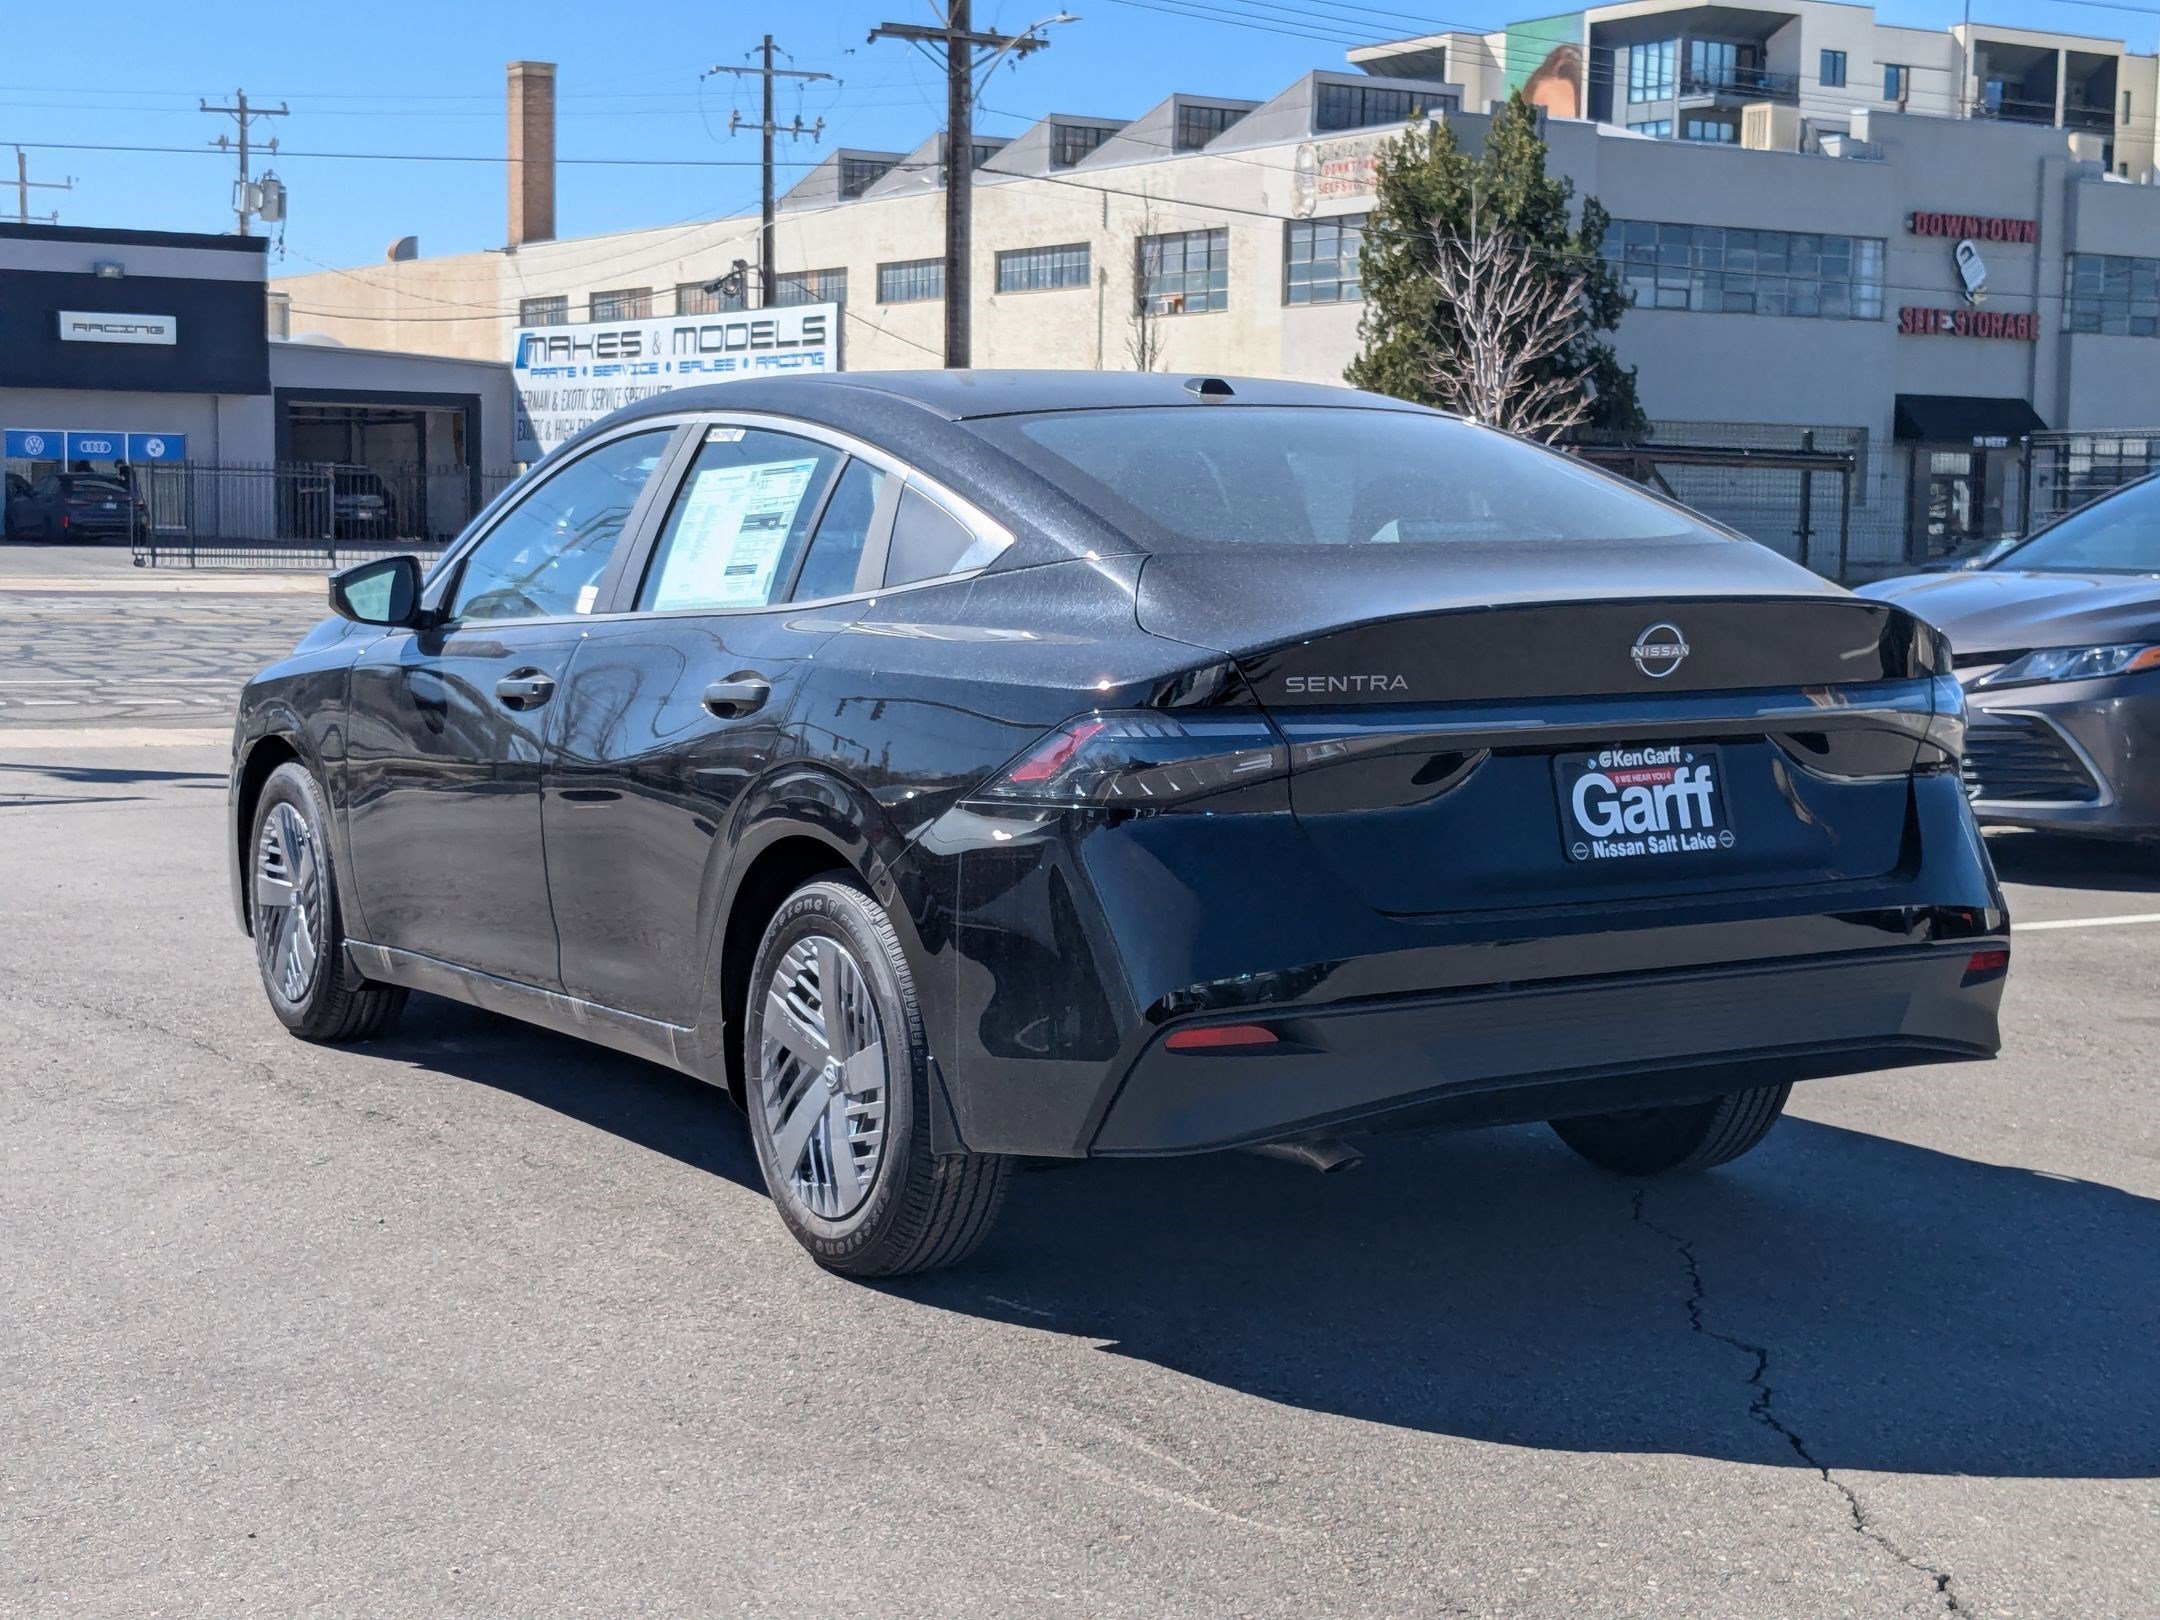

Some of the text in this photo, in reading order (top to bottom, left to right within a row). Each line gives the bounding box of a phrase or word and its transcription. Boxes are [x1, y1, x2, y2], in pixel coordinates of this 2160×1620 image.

[1913, 212, 2037, 243] DOWNTOWN
[72, 322, 165, 335] RACING
[1899, 306, 2040, 341] SELF STORAGE
[525, 315, 826, 364] MAKES & MODELS
[530, 352, 825, 379] PARTS SERVICE SALES RACING
[561, 389, 591, 412] EXOTIC
[591, 387, 625, 411] SERVICE
[1631, 644, 1690, 658] NISSAN
[1284, 674, 1409, 693] SENTRA
[1612, 746, 1681, 767] Ken Garff
[1620, 772, 1667, 783] WE HEAR YOU
[1572, 765, 1714, 838] Garff
[1592, 832, 1717, 859] Nissan Salt Lake
